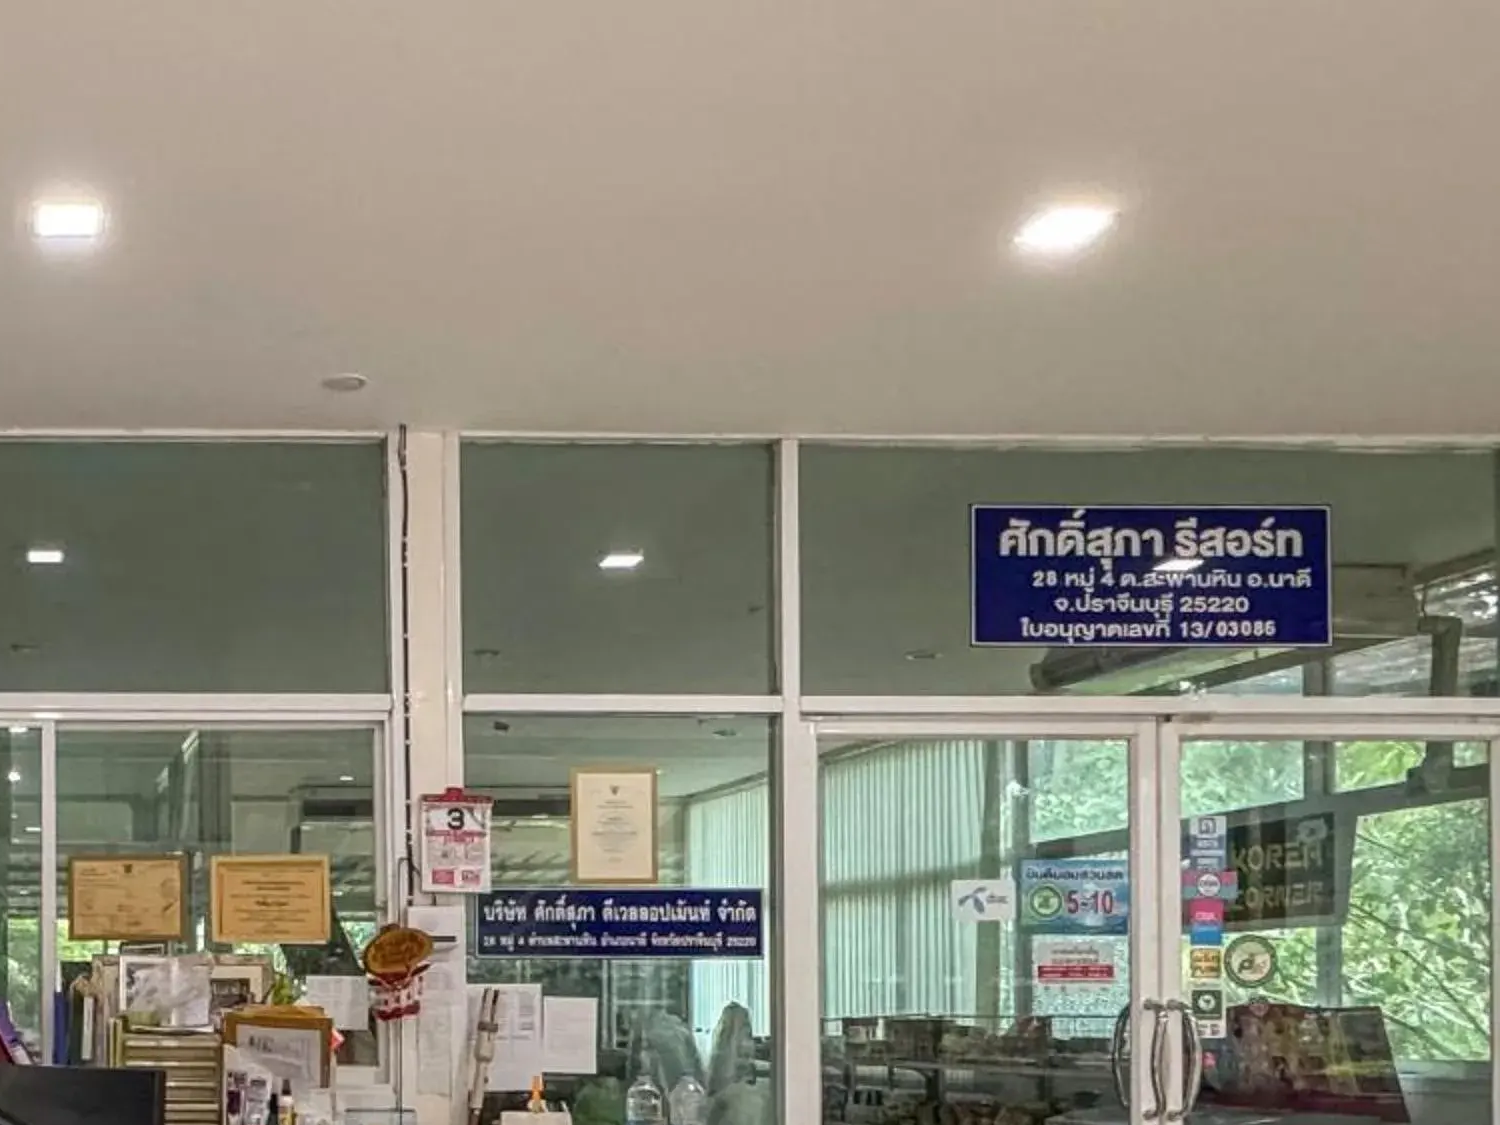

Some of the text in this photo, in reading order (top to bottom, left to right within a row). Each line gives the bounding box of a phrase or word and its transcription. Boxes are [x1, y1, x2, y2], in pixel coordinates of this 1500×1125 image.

[1174, 516, 1302, 558] รีสอร์ท
[1032, 571, 1058, 588] 28
[1100, 570, 1114, 588] 4
[1179, 597, 1250, 613] 25220
[1179, 620, 1277, 639] 13/03086
[447, 807, 465, 831] 3
